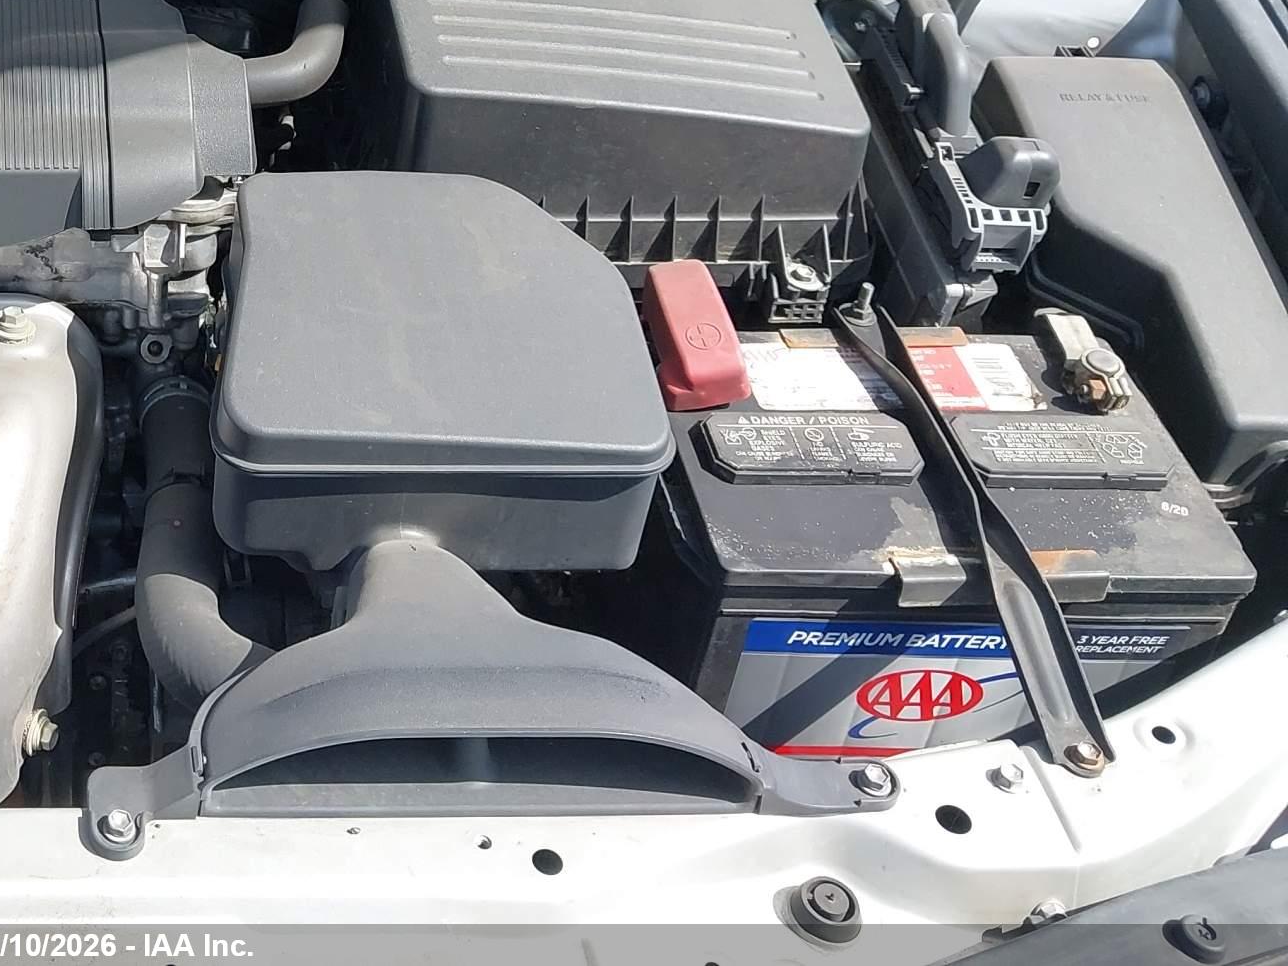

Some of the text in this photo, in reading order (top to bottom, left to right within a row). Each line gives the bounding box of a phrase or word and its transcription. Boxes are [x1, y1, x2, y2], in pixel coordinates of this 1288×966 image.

[750, 415, 805, 426] DANGER
[818, 416, 871, 426] POISON
[787, 631, 904, 648] PREMIUM
[1076, 635, 1170, 645] 3 YEAR FREE
[1075, 645, 1165, 654] REPLACEMENT
[862, 671, 978, 721] AAA
